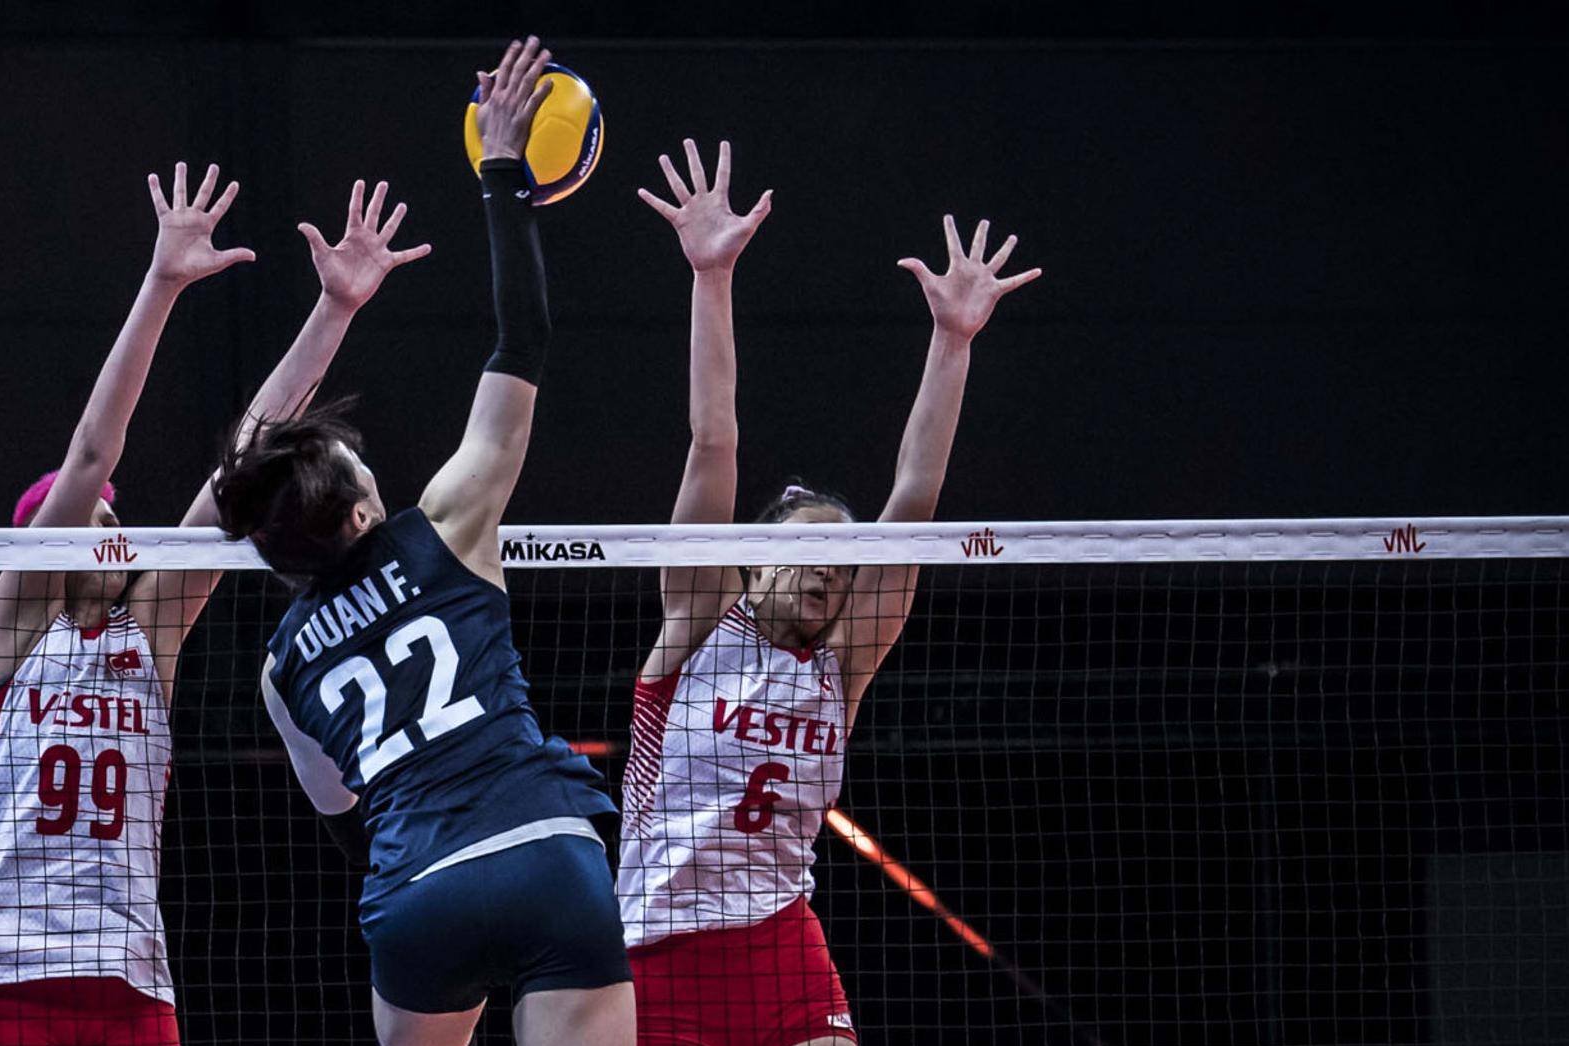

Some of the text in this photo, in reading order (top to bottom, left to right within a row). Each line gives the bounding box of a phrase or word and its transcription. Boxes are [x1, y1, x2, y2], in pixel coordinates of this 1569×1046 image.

[93, 533, 138, 564] VNL
[501, 532, 606, 561] MIKASA
[961, 527, 1004, 558] VNL
[1384, 524, 1426, 553] VNL
[295, 559, 421, 663] DUAN F.
[29, 687, 150, 735] VESTEL
[320, 615, 486, 785] 22
[713, 696, 838, 756] VESTEL
[36, 744, 128, 841] 99
[733, 761, 790, 834] 6
